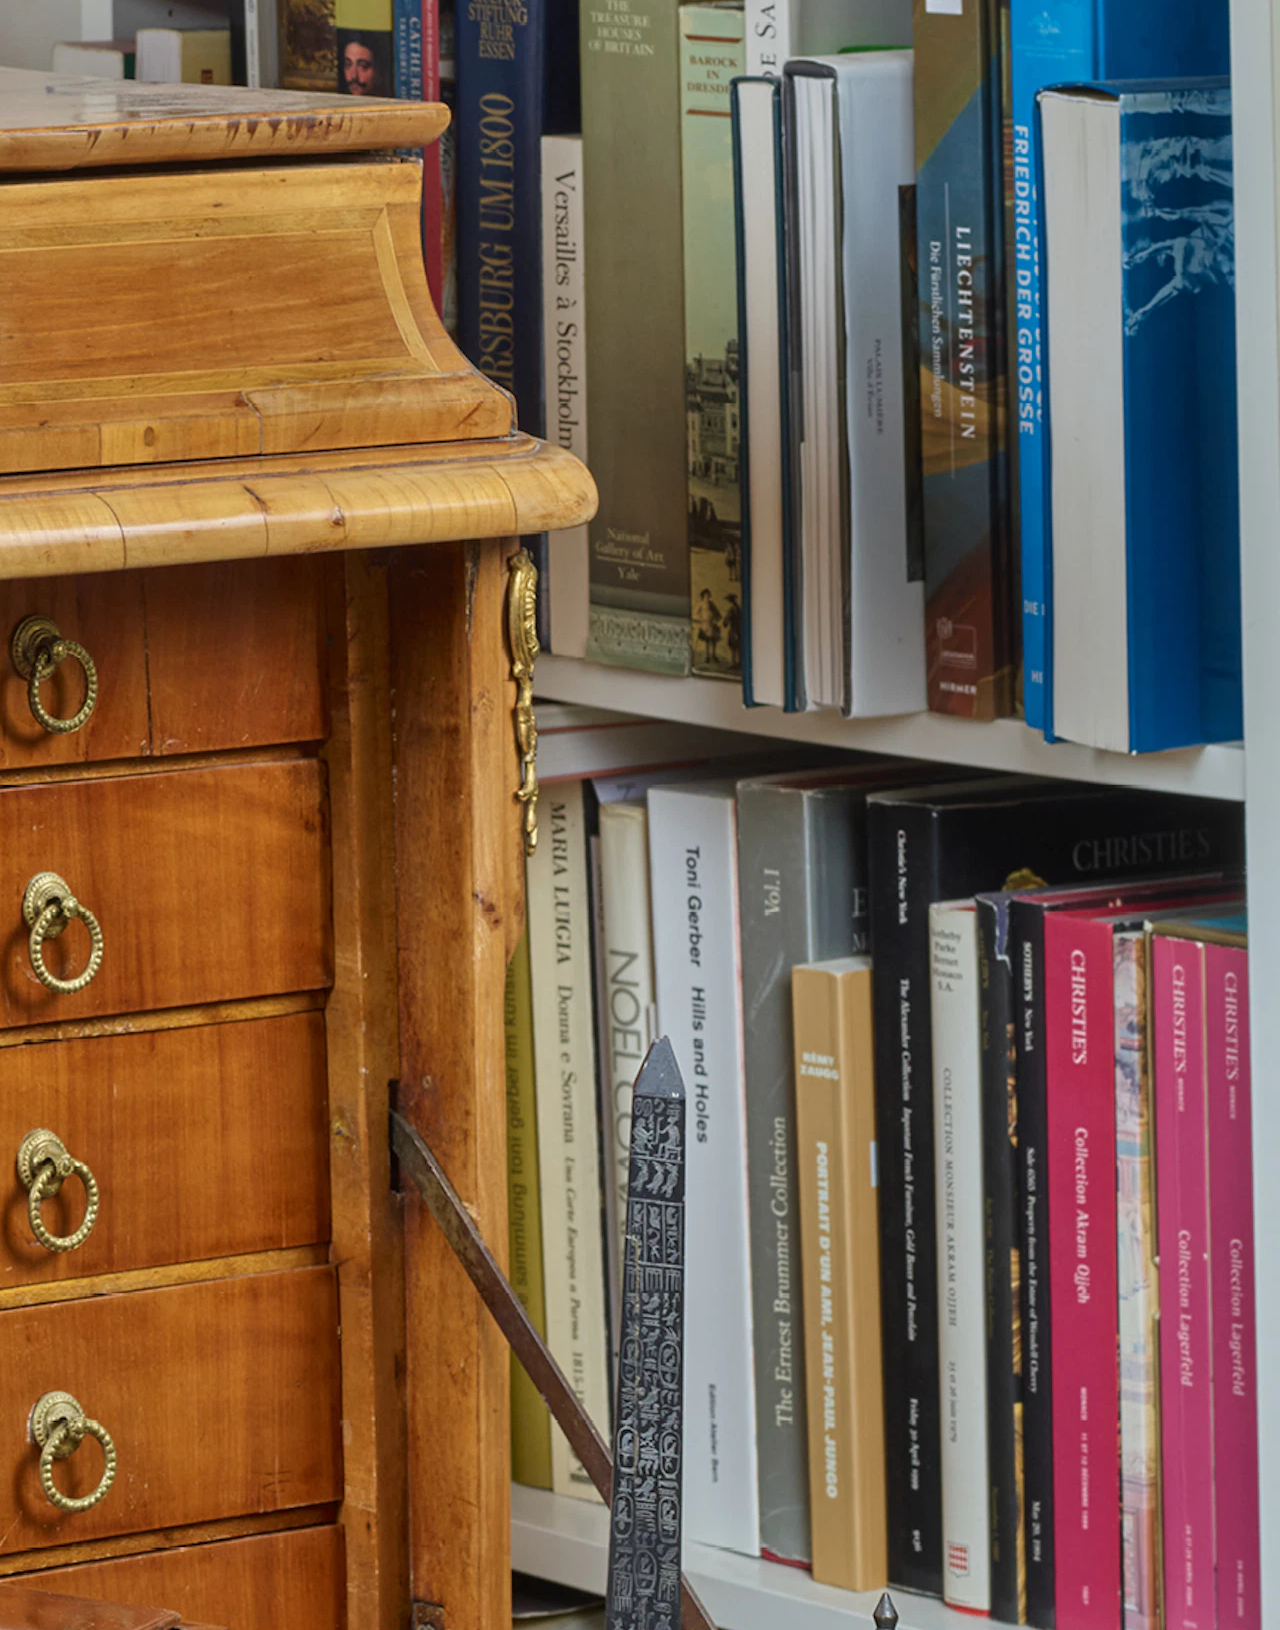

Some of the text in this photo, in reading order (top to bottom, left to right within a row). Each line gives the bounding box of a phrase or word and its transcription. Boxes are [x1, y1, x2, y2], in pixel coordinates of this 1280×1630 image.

[468, 3, 529, 27] STIFTUNG
[478, 40, 516, 60] ESSEN
[689, 54, 739, 68] BAROCK
[555, 169, 580, 451] Versailles à Stockholm
[955, 226, 976, 440] LIECHTENSTEIN
[1014, 124, 1034, 436] FRIEDRICH DER GROSSE
[685, 847, 710, 1146] Toni Gerber Hills and Holes
[1070, 949, 1087, 1065] CHRISTIE'S
[1171, 964, 1187, 1074] CHRISTIE'S
[1224, 971, 1240, 1082] CHRISTIE'S
[768, 1116, 794, 1428] The Ernest Brummer Collection
[1073, 1127, 1091, 1304] Collection Akram Ojjeh
[816, 1142, 838, 1499] PORTRAIT D'UN AMI, JEAN-PAUL JUNGO
[1177, 1230, 1195, 1388] Collection Lagerfeld
[1228, 1238, 1246, 1398] Collection Lagerfeld
